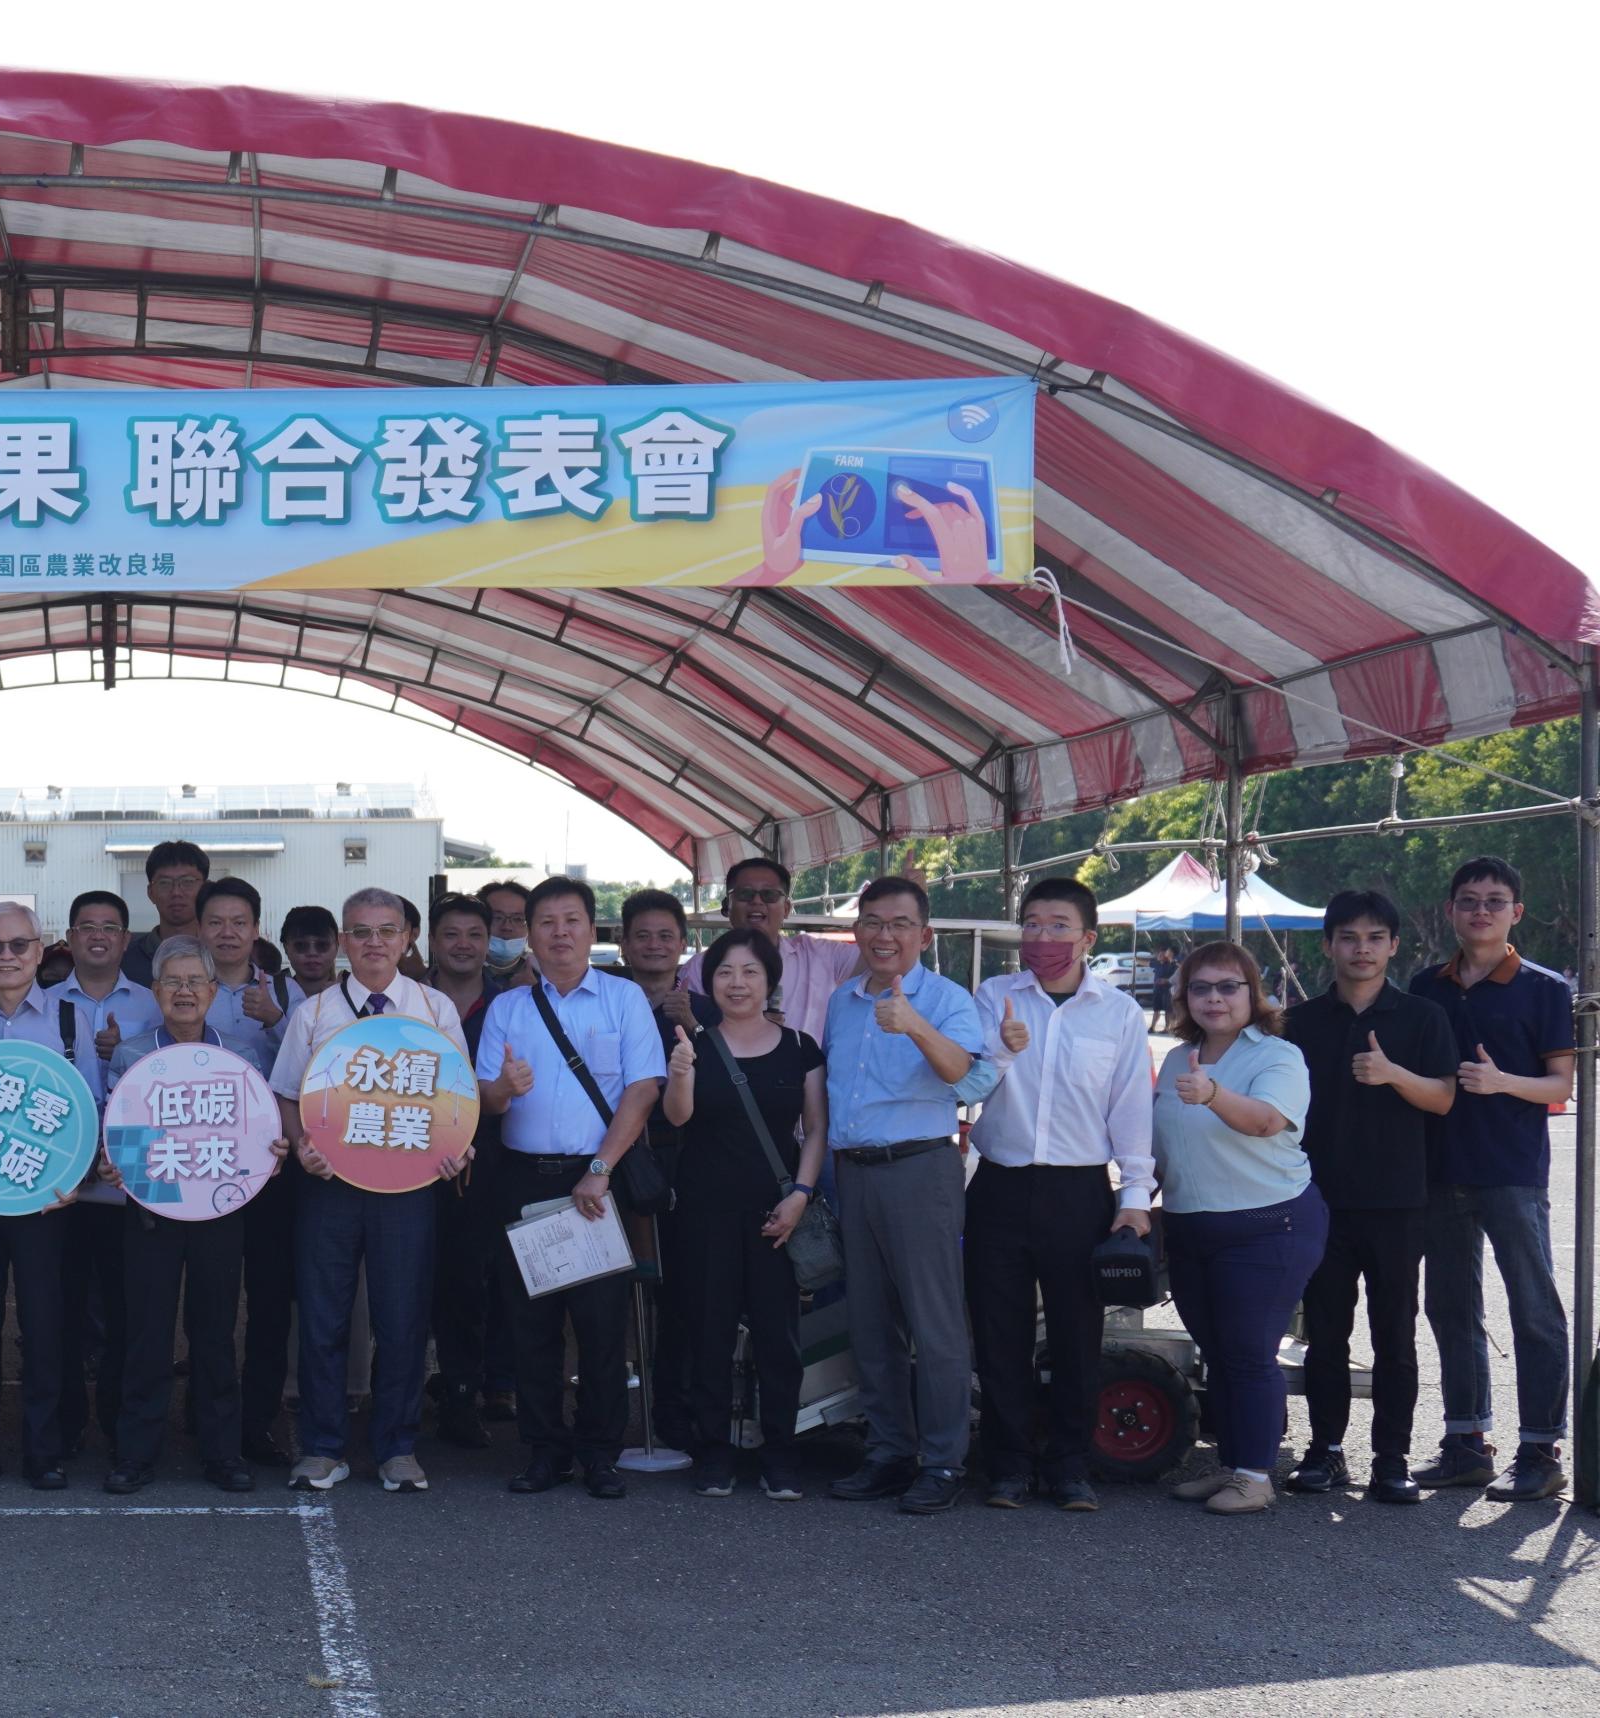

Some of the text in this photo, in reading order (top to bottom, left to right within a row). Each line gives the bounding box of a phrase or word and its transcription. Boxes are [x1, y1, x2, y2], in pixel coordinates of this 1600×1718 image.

[129, 409, 726, 522] 聯合發表會
[834, 454, 864, 469] FARM
[347, 1048, 436, 1097] 永續
[148, 1081, 236, 1127] 低碳
[343, 1101, 432, 1151] 農業
[150, 1136, 237, 1180] 未來
[1100, 1266, 1142, 1278] MIPRO
